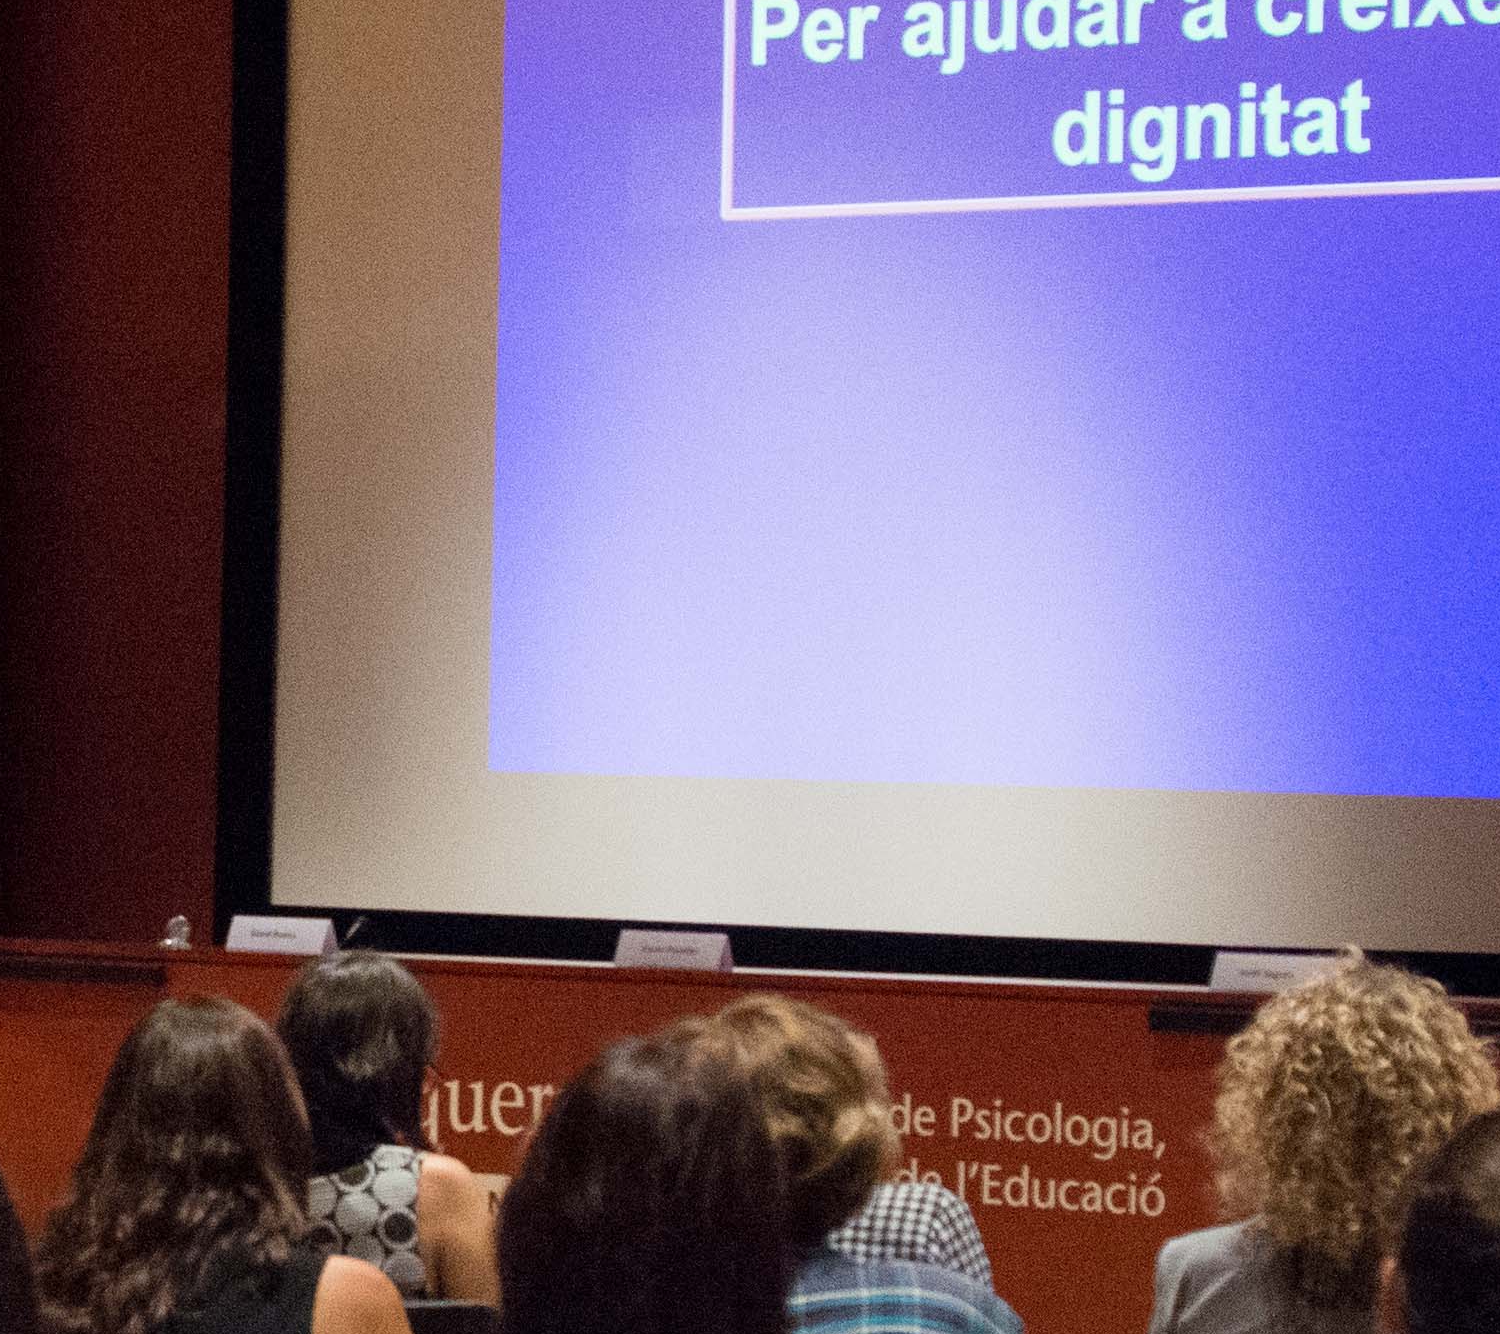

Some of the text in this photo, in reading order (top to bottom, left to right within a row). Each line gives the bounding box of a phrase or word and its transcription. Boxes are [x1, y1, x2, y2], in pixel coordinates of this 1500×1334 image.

[1052, 79, 1372, 183] dignitat
[890, 1092, 1166, 1161] de Psicologia,
[957, 1159, 1166, 1218] l'Educació
